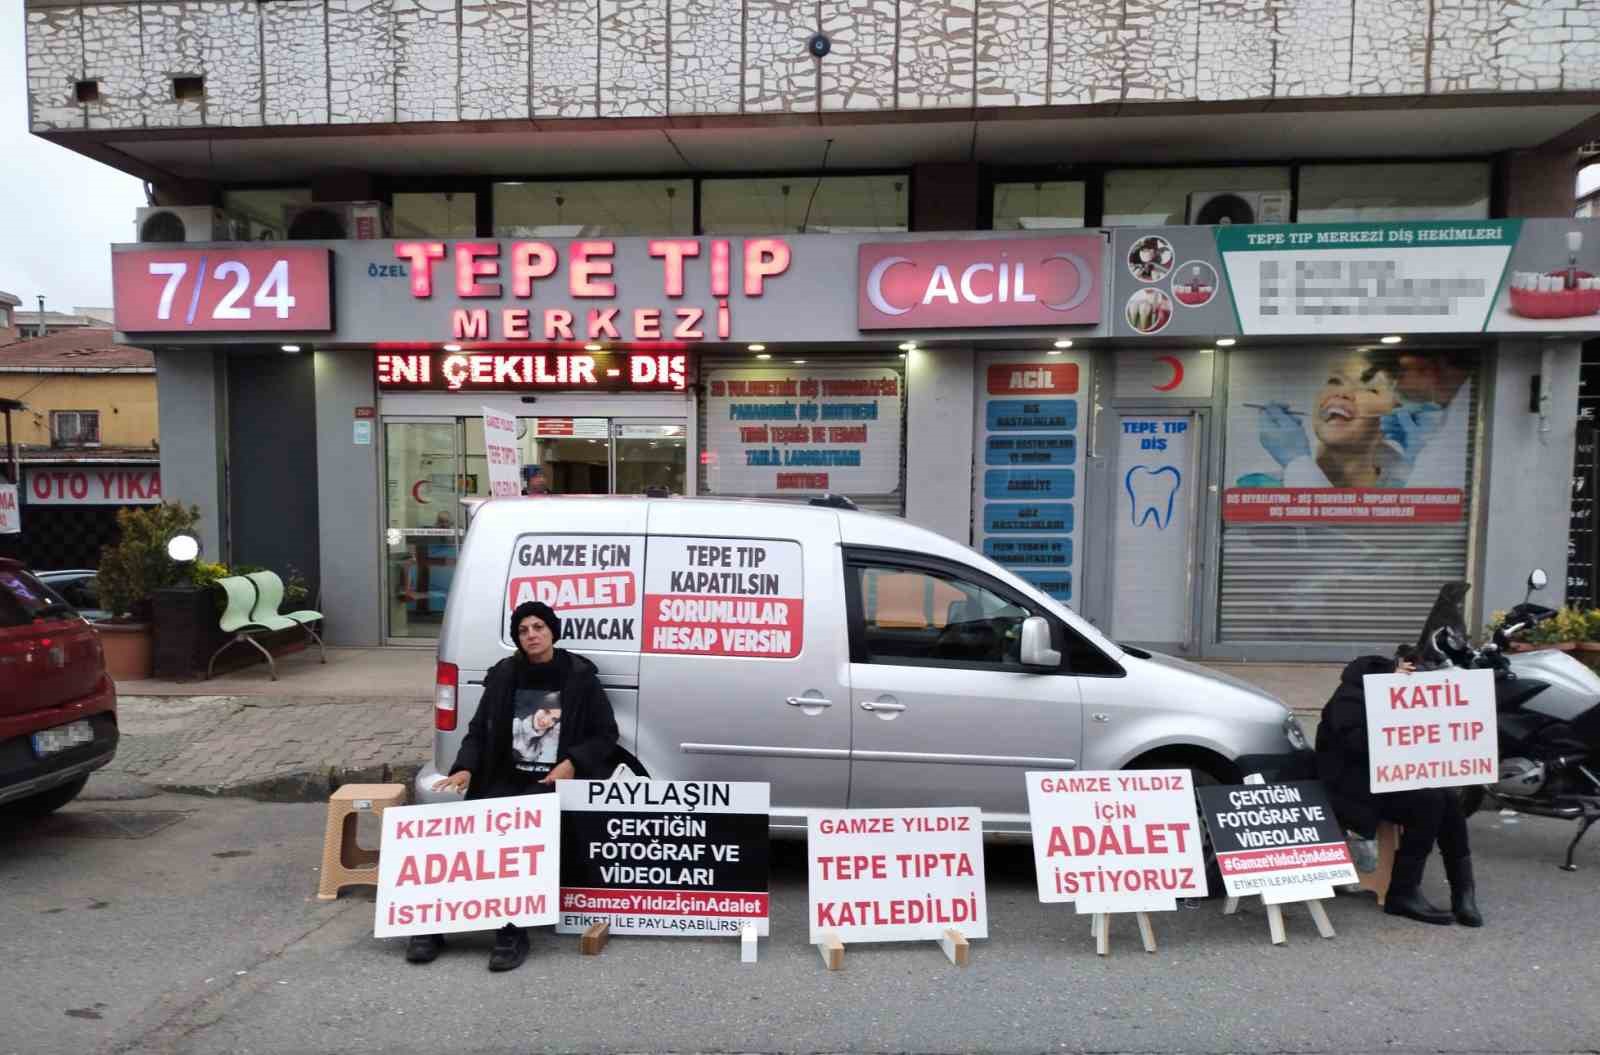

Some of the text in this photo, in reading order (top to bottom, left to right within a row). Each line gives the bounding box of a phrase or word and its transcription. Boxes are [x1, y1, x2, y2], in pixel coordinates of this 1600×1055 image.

[1247, 226, 1502, 245] TEPE TIP MERKEZİ DİŞ HEKİMLERİ
[368, 262, 407, 278] ÖZEL
[394, 239, 794, 298] TEPE TIP
[921, 252, 1037, 305] ACİL
[149, 255, 296, 325] 7/24
[452, 300, 732, 339] MERKEZİ
[1009, 368, 1055, 389] ACİL
[1122, 421, 1187, 434] TEPE TIP
[1141, 437, 1167, 450] DİŞ
[32, 472, 89, 499] OTO
[518, 543, 630, 571] GAMZE İÇİN
[686, 545, 766, 568] TEPE TIP
[515, 576, 630, 608] ADALET
[670, 571, 779, 595] KAPATILSIN
[658, 598, 788, 625] SORUMLULAR
[560, 618, 635, 640] AYACAK
[652, 626, 792, 653] HESAP VERSİN
[1389, 678, 1469, 710] KATİL
[1382, 721, 1484, 747] TEPE TIP
[1376, 758, 1492, 783] KAPATILSIN
[588, 782, 730, 811] PAYLAŞIN
[1040, 776, 1184, 793] GAMZE YILDIZ
[1229, 785, 1302, 809] ÇEKTİĞİN
[396, 807, 543, 840] KIZIM İÇİN
[1095, 801, 1137, 821] İÇİN
[1216, 806, 1326, 828] FOTOĞRAF VE
[607, 815, 706, 839] ÇEKTİĞİN
[820, 816, 970, 834] GAMZE YILDIZ
[1236, 826, 1320, 848] VİDEOLARI
[589, 839, 740, 862] FOTOĞRAF VE
[1047, 823, 1190, 857] ADALET
[395, 844, 545, 887] ADALET
[599, 863, 714, 885] VİDEOLARI
[817, 853, 974, 880] TEPE TIPTA
[1055, 866, 1196, 894] İSTİYORUZ
[388, 894, 546, 925] İSTİYORUM
[817, 892, 977, 927] KATLEDİLDİ
[616, 916, 635, 928] İLE
[638, 917, 751, 932] PAYLAŞABİLİRSİ
